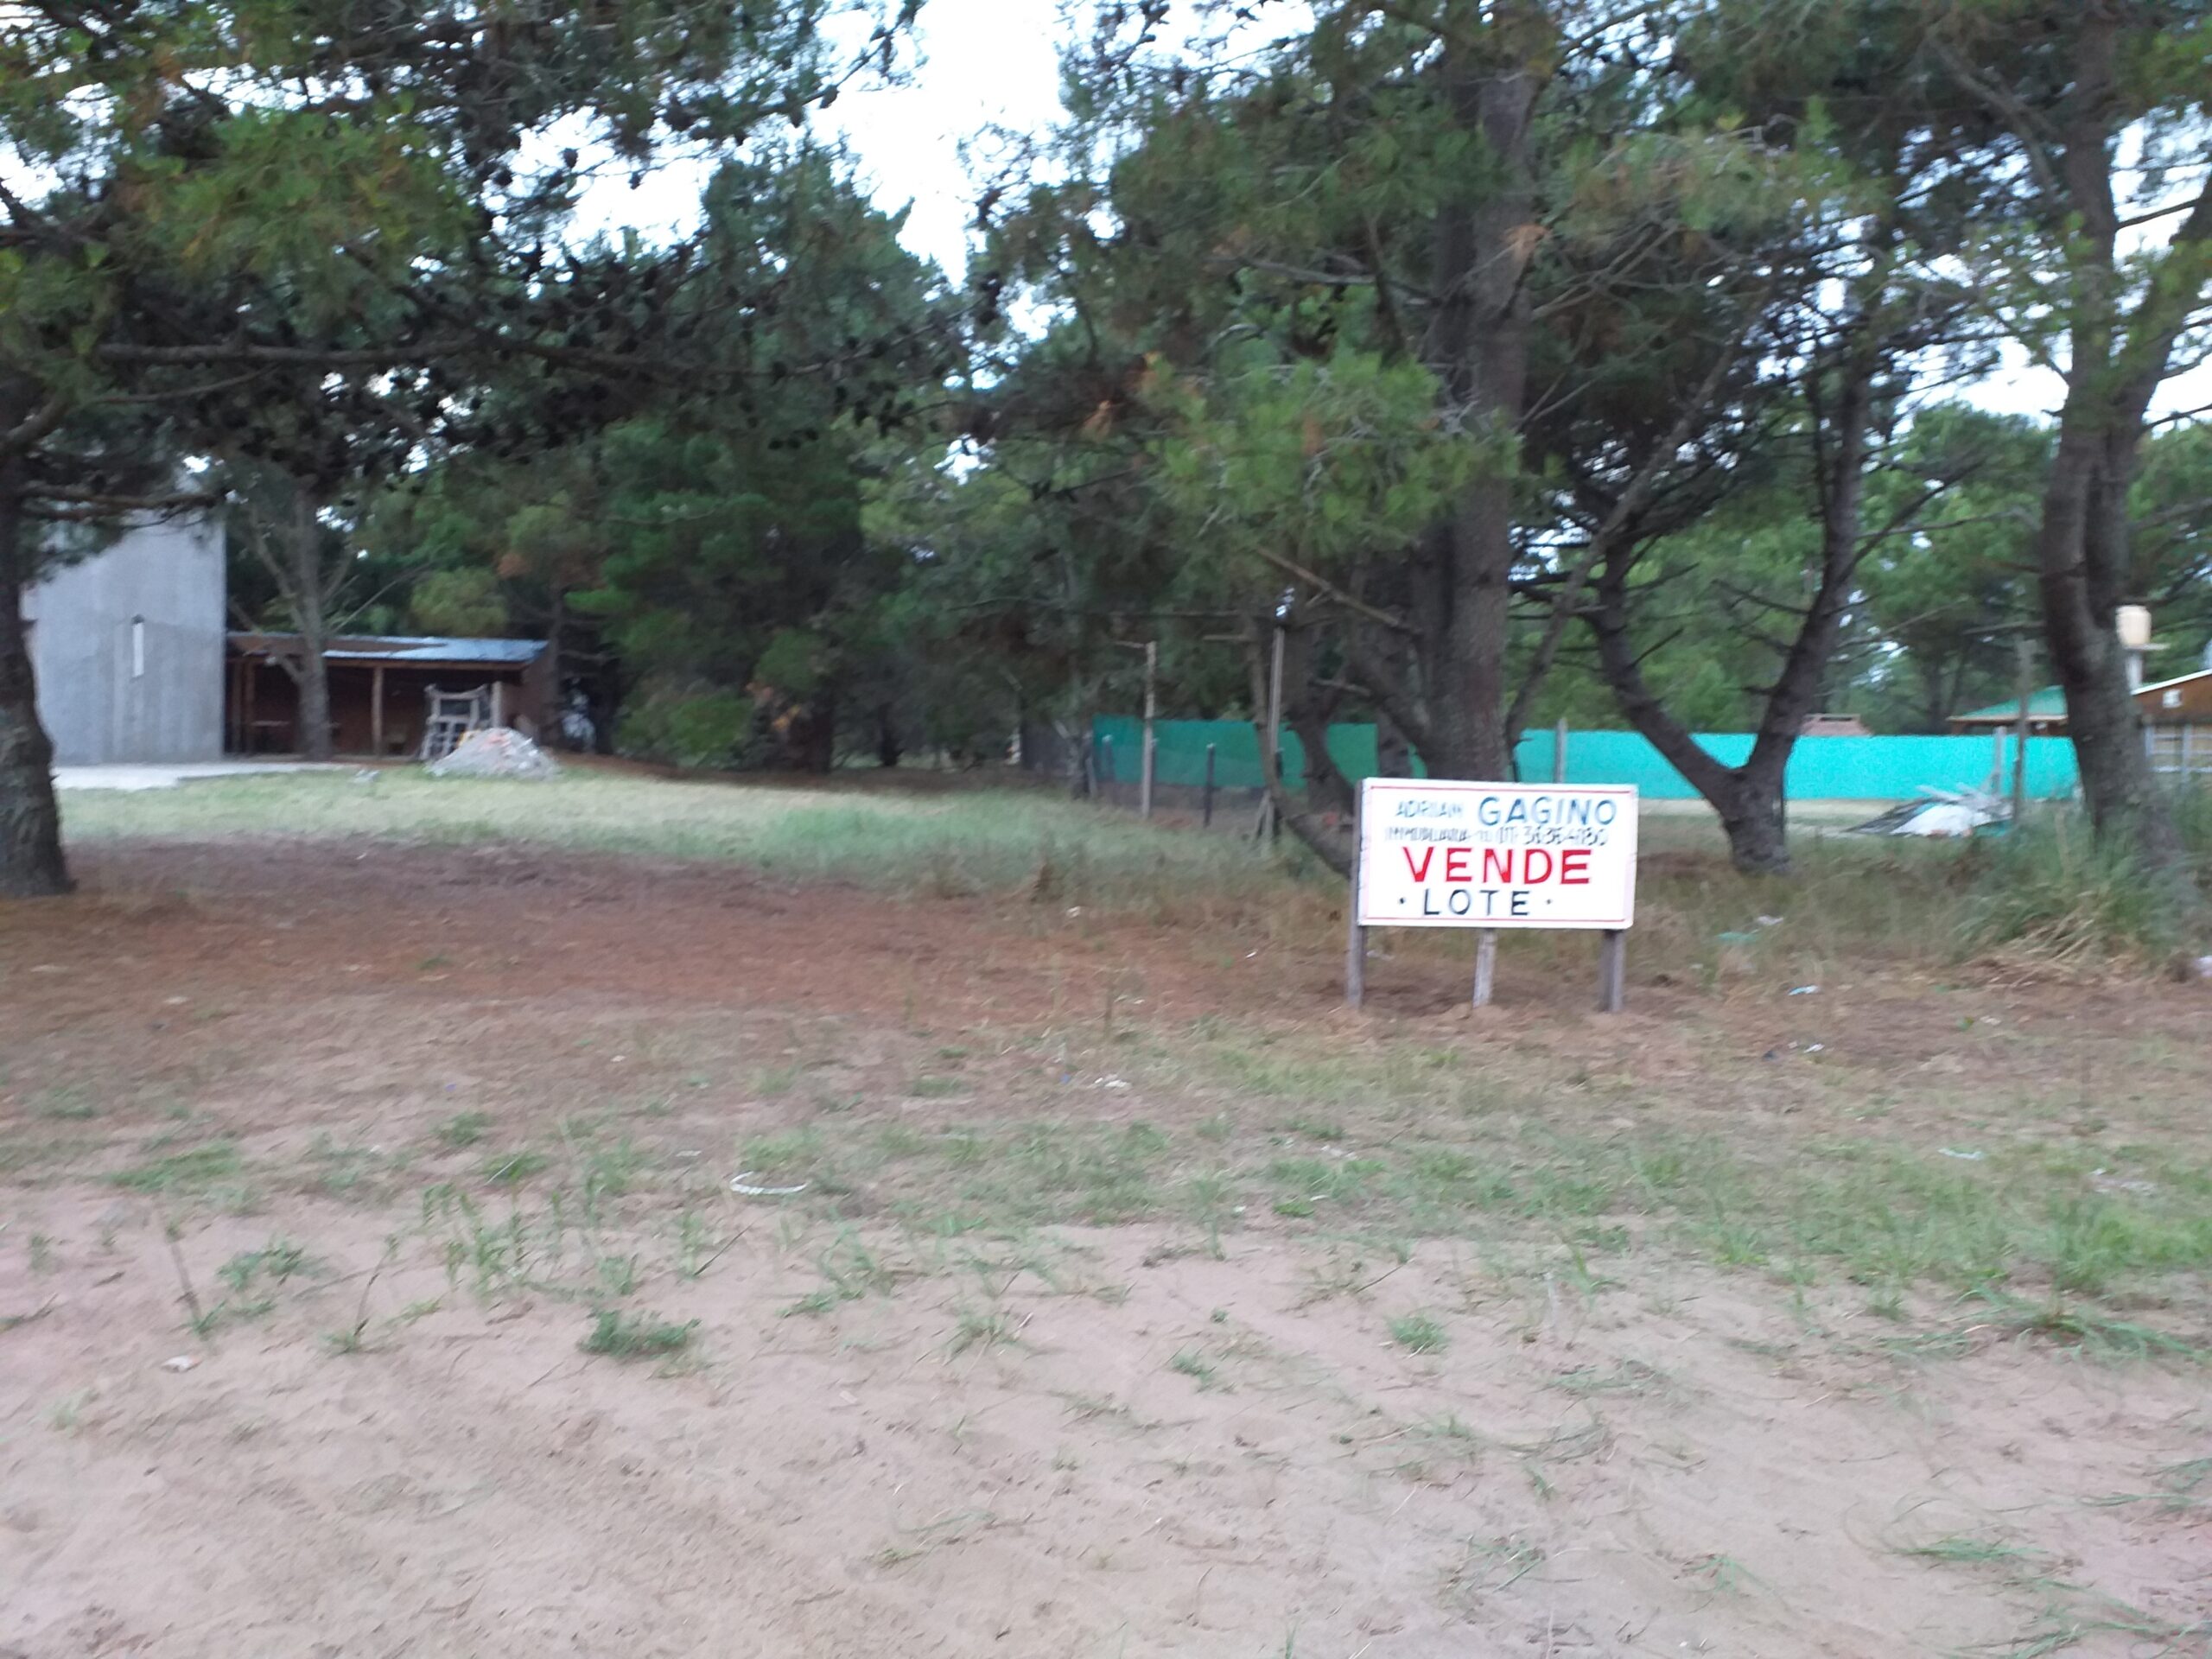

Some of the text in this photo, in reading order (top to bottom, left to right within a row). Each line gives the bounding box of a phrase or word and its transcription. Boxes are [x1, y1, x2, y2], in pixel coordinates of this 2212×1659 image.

[1478, 795, 1618, 827] GAGINO
[1402, 846, 1592, 885] VENDE
[1422, 888, 1531, 916] LOTE
